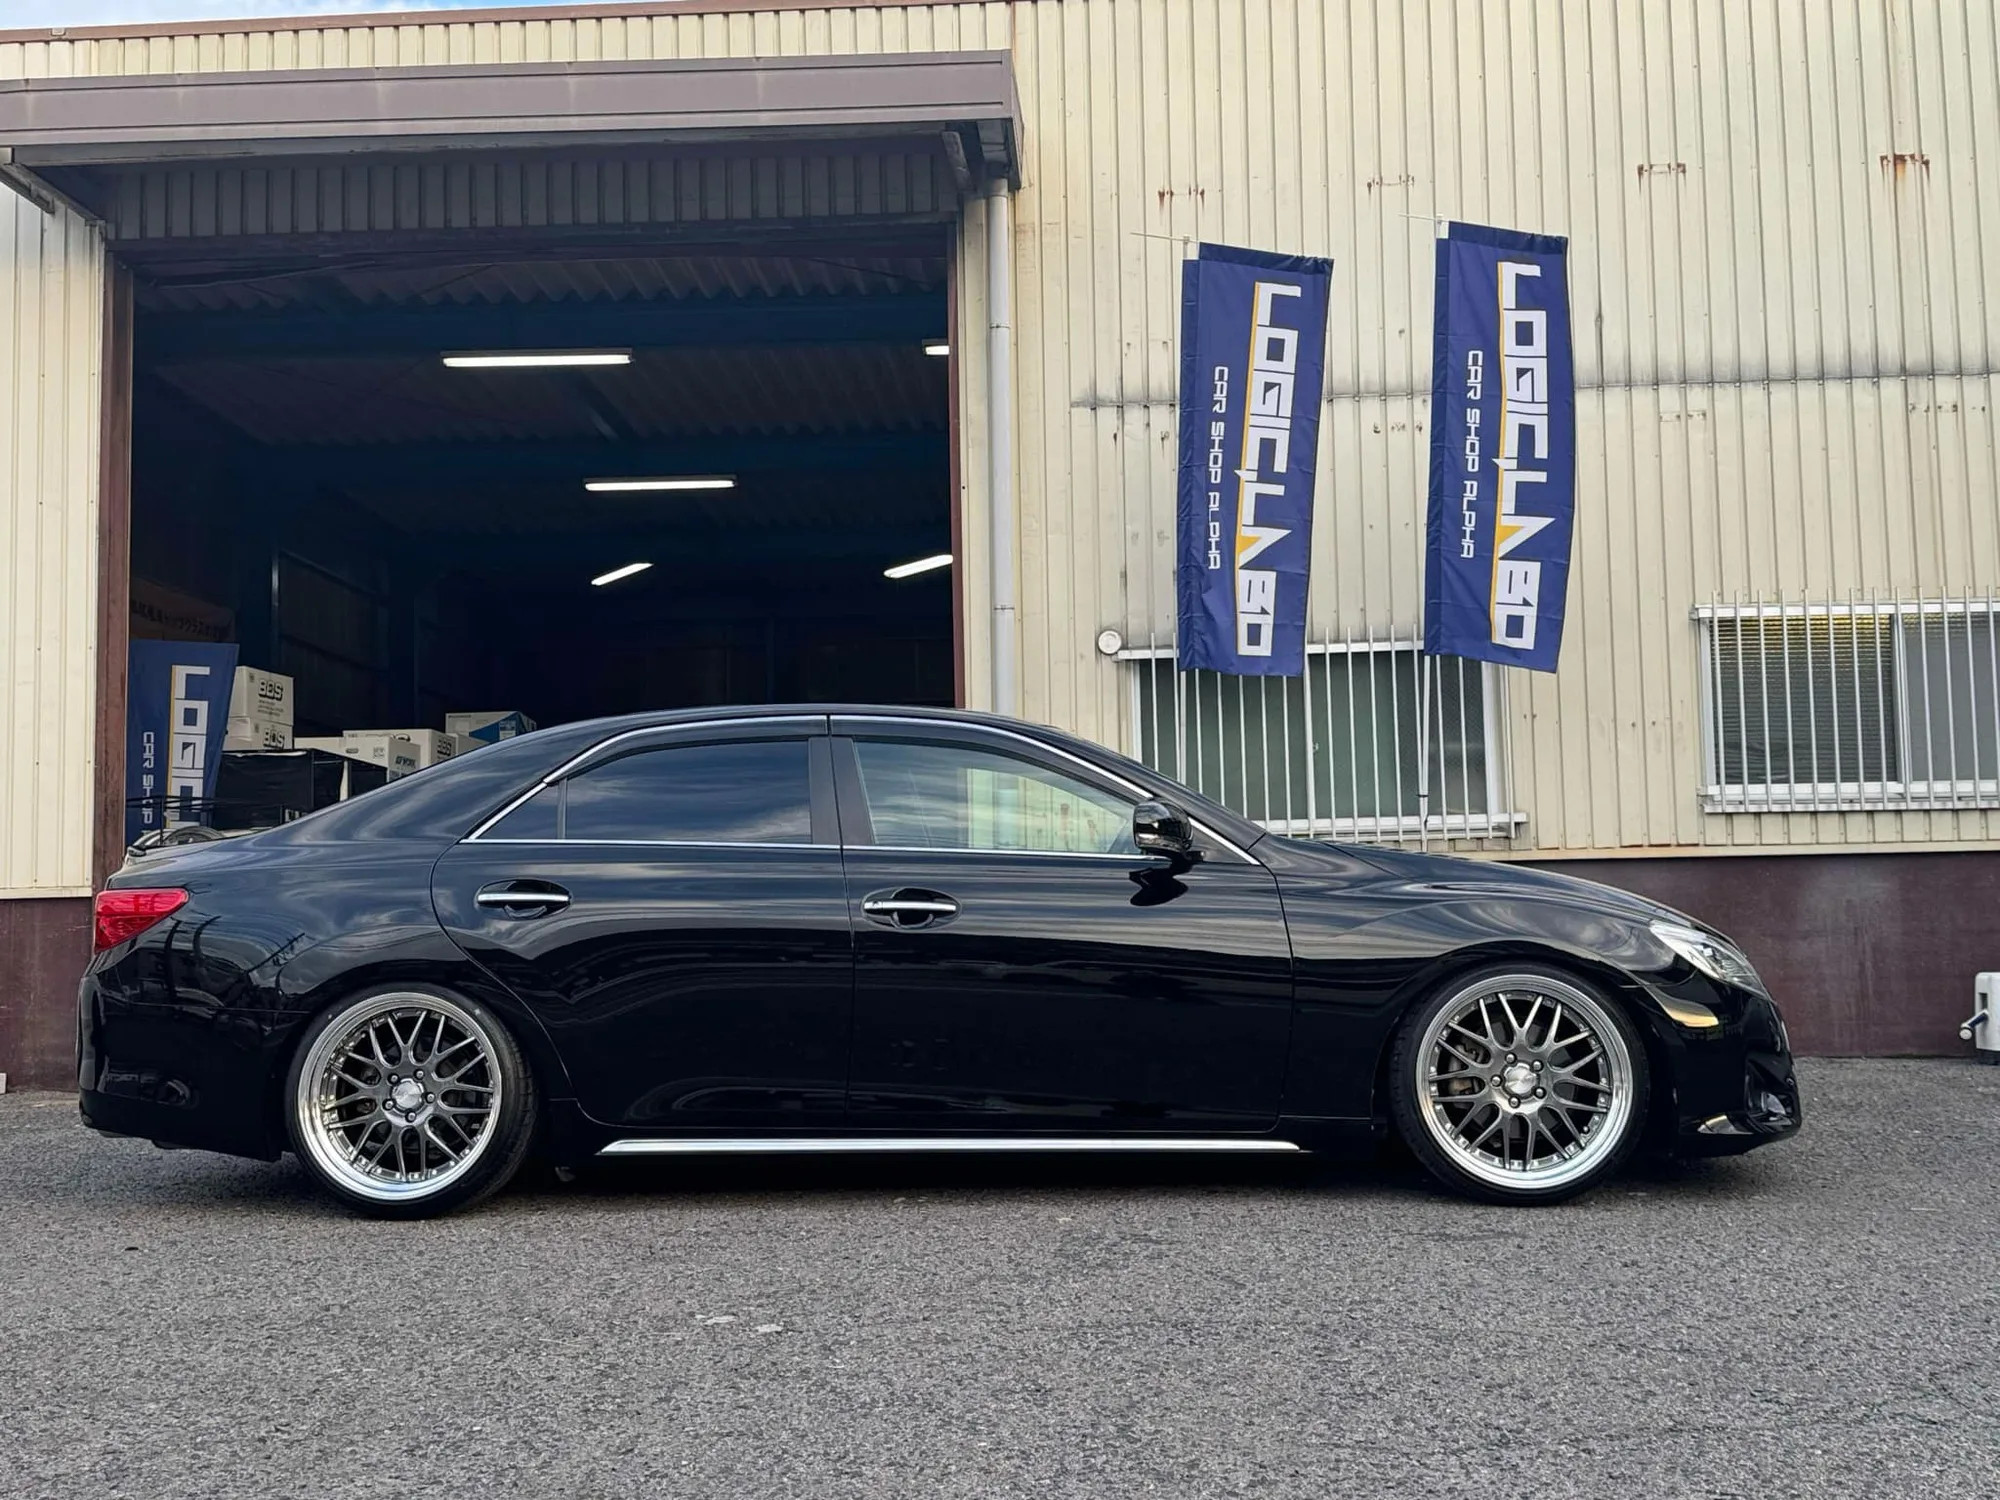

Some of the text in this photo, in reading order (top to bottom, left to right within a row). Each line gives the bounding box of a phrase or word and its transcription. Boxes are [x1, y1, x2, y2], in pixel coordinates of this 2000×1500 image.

[1207, 366, 1229, 570] CAR SHOP ALPHA
[1461, 350, 1483, 559] CAR SHOP ALPHA
[142, 731, 154, 769] CAR
